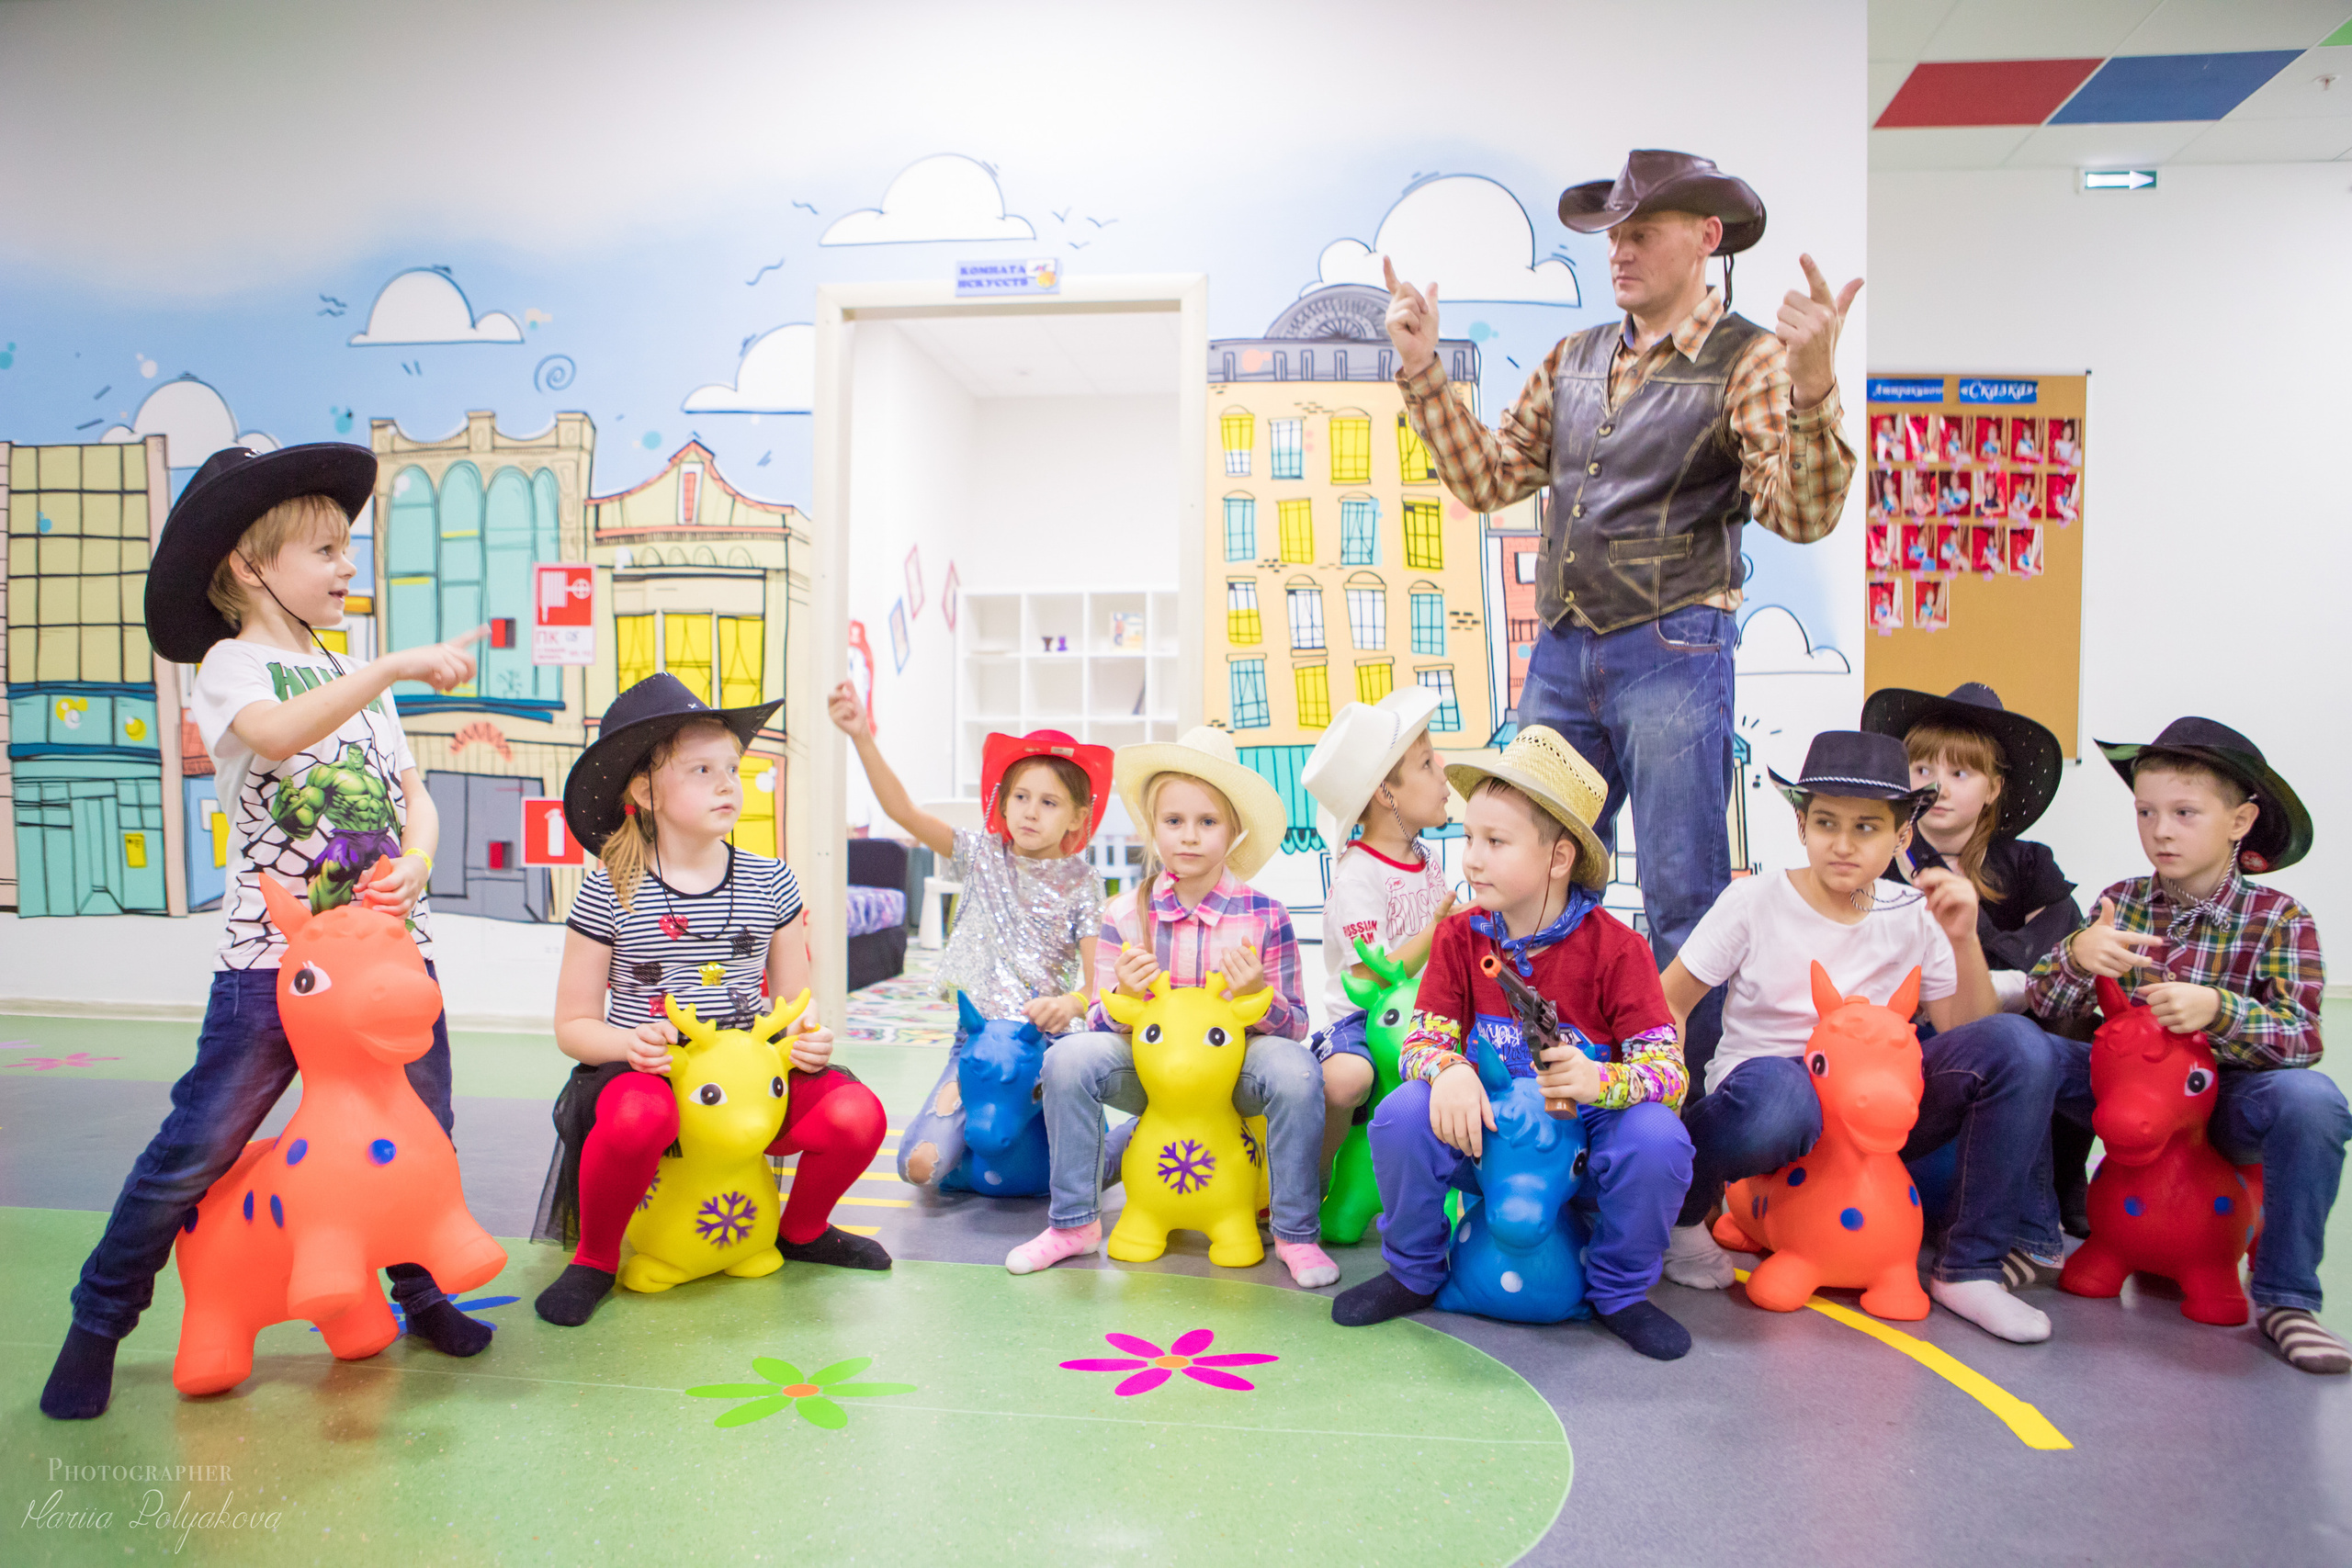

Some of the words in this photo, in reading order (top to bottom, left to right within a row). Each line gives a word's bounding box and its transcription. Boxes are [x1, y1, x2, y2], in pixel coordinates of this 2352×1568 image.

[960, 265, 1026, 275] КОМНАТА
[957, 277, 1028, 288] ИСКУССТВ
[536, 630, 559, 644] ПК
[1350, 931, 1375, 949] TAM
